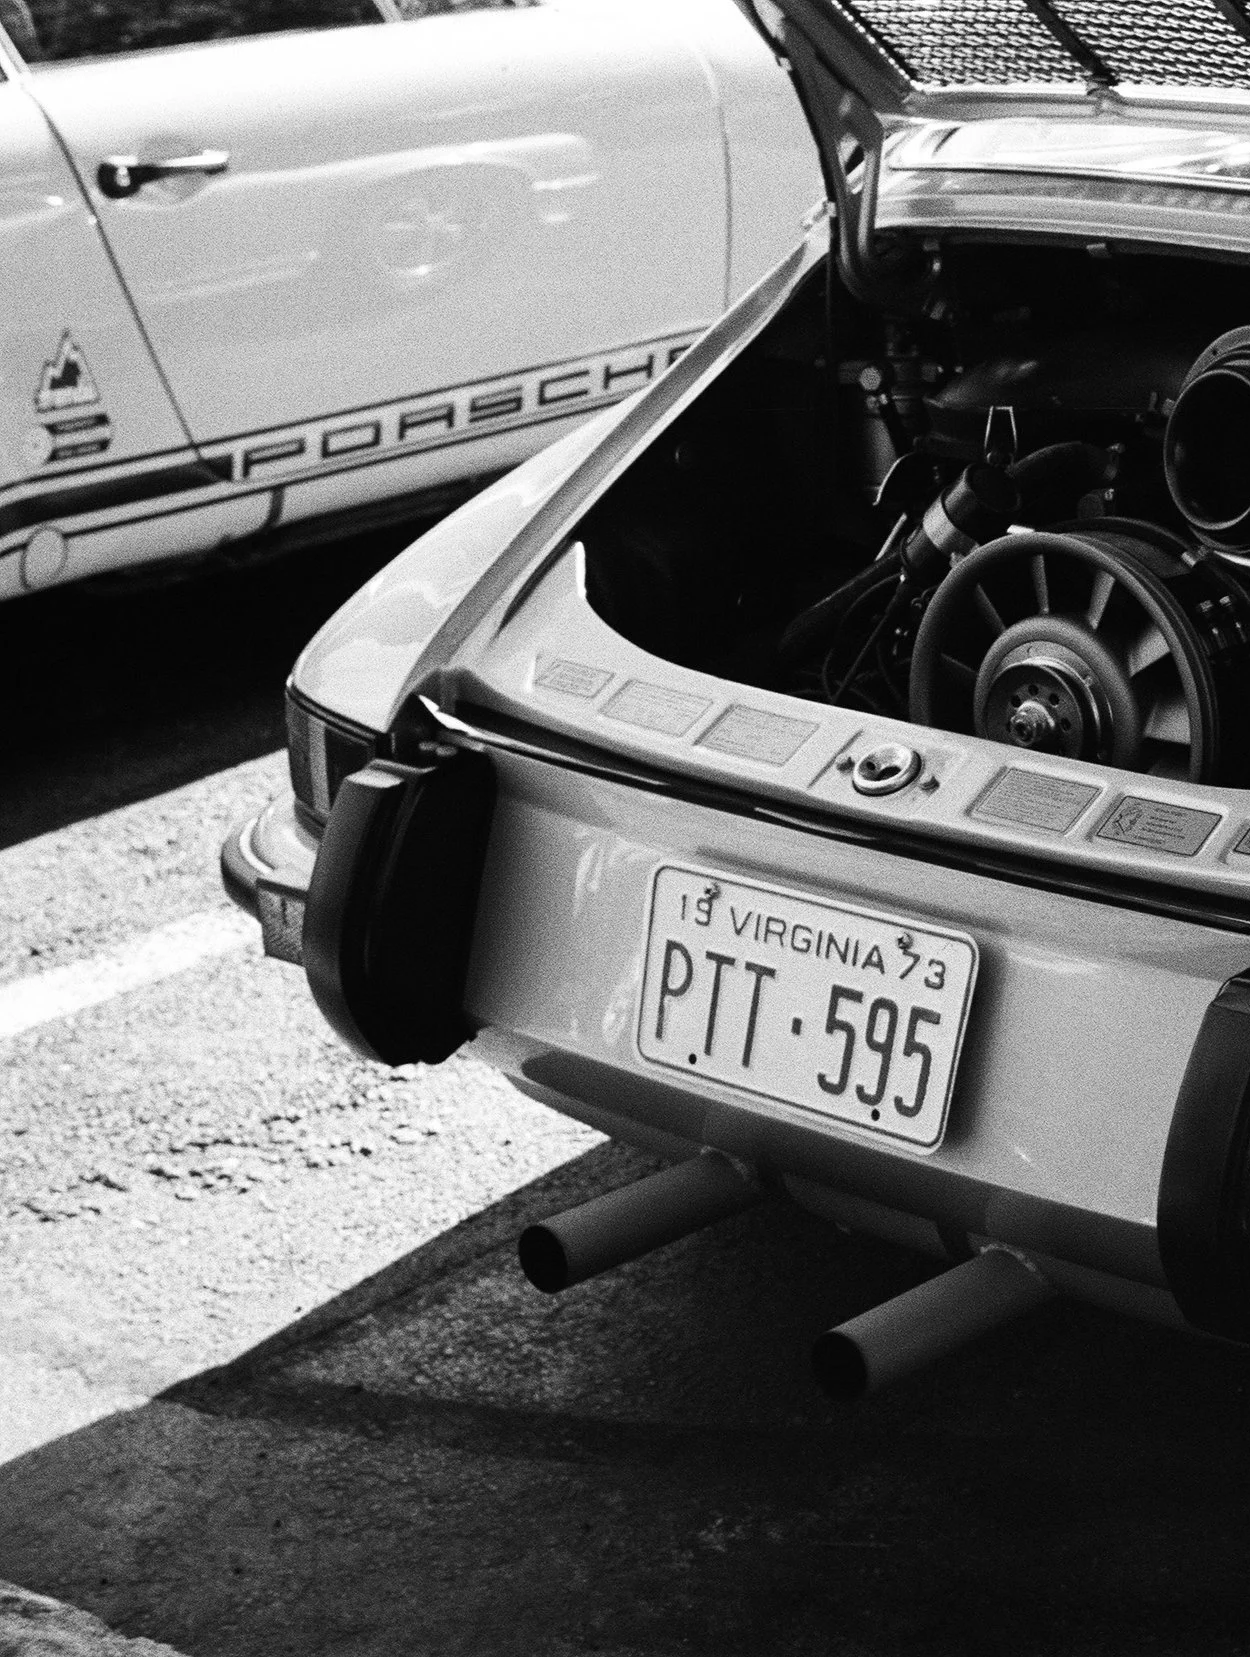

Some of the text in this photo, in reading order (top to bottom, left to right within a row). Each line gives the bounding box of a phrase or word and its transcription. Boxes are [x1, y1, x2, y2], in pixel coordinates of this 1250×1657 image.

[681, 893, 946, 990] 19 VIRGINIA 73
